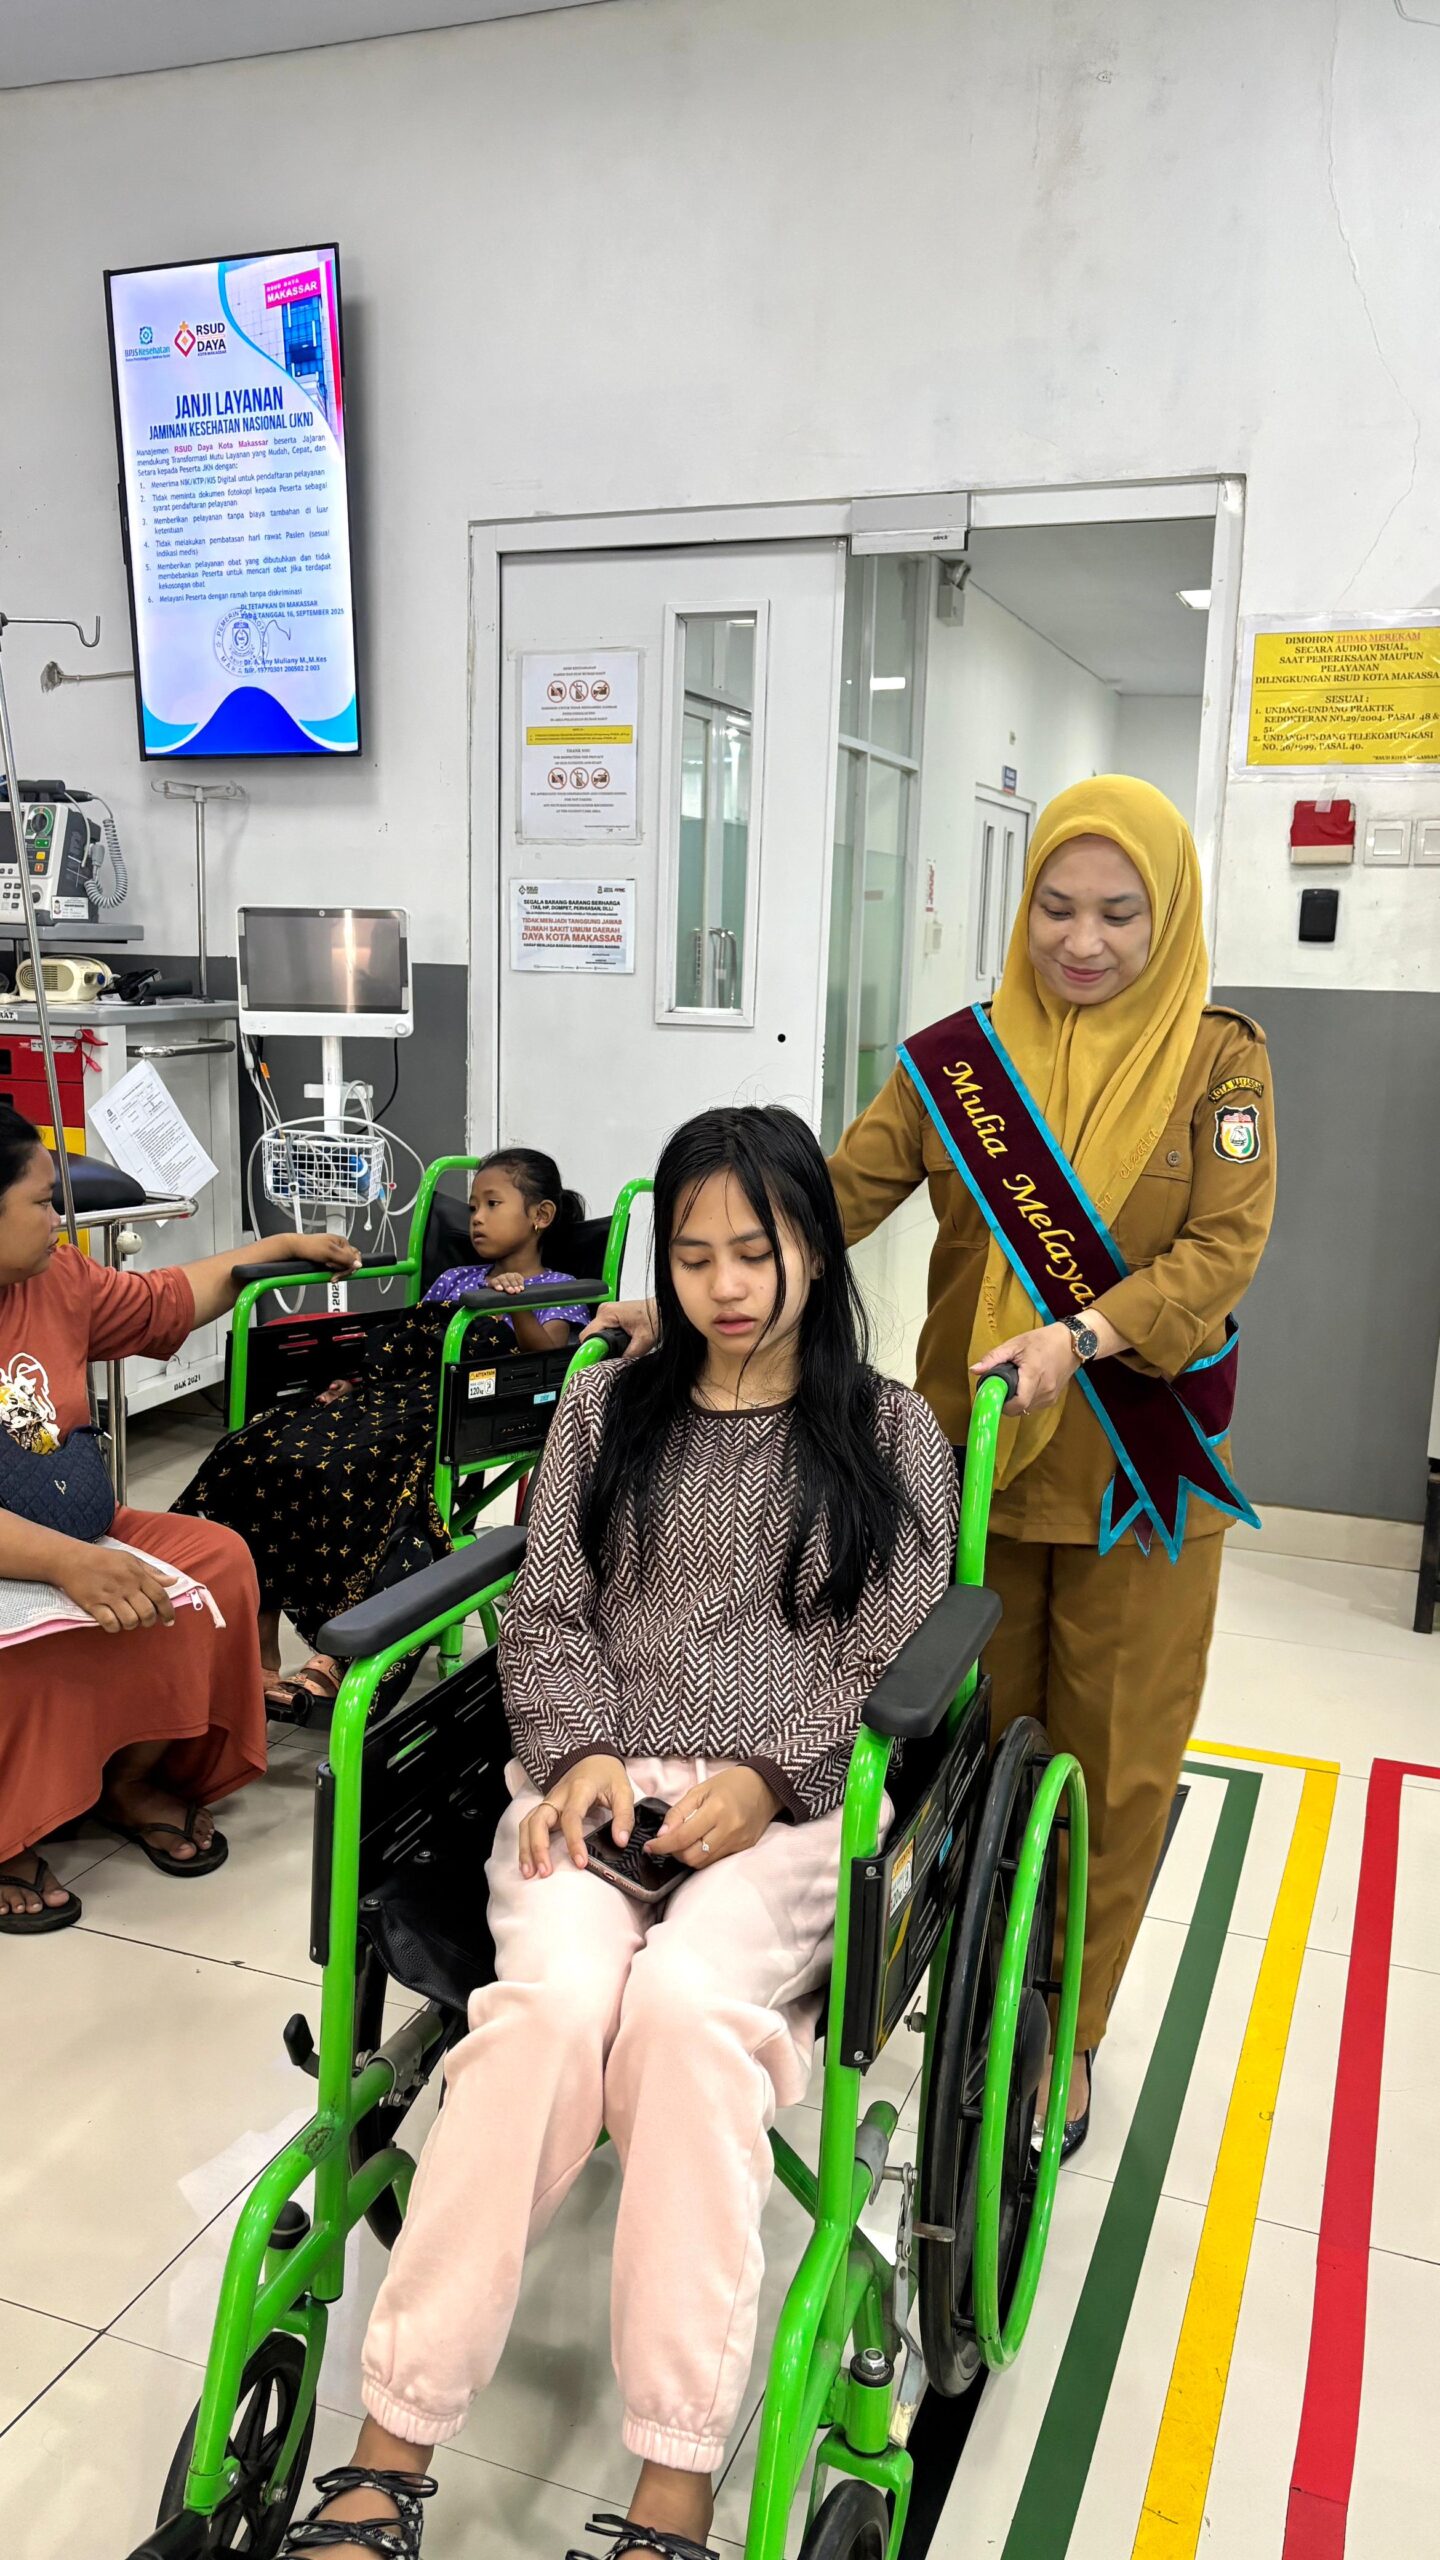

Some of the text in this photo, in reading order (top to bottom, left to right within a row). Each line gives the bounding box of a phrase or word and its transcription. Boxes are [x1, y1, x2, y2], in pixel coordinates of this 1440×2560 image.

[267, 281, 318, 303] MAKASSAR
[196, 323, 225, 335] RSUD
[139, 346, 170, 355] Kesehatan
[197, 339, 226, 352] DAYA
[175, 386, 284, 420] JANJI LAYANAN
[149, 412, 314, 440] JAMINAN KESEHATAN NASIONAL (JKN)
[137, 446, 169, 457] Manajemen
[174, 445, 192, 453] RSUD
[198, 444, 213, 452] Daya
[239, 439, 268, 448] Makassar
[274, 436, 297, 445] beserta
[303, 434, 326, 444] Jajaran
[137, 457, 170, 467] mendukung
[172, 454, 207, 464] Transformasi
[226, 451, 250, 461] Layanan
[252, 450, 267, 460] yang
[268, 448, 289, 457] Mudah,
[292, 446, 312, 456] Cepat,
[138, 462, 238, 477] Setara kepada Peserta JKN dengan:
[151, 479, 179, 488] Menerima
[218, 475, 237, 485] Digital
[238, 474, 255, 482] untuk
[256, 470, 292, 481] pendaftaran
[294, 468, 325, 479] pelayanan
[152, 493, 168, 501] Tidak
[171, 491, 196, 499] meminta
[199, 489, 225, 498] dokumen
[228, 488, 252, 497] fotokopi
[255, 485, 276, 495] kepada
[279, 483, 302, 492] Peserta
[305, 482, 327, 491] sebagai
[153, 499, 237, 512] syarat pendaftaran pelayanan
[154, 505, 329, 525] Memberikan pelayanan tanpa biaya tambahan di luar
[155, 526, 184, 535] ketentuan
[156, 539, 171, 547] Tidak
[175, 538, 206, 546] melakukan
[209, 535, 245, 546] pembatasan
[264, 533, 282, 541] rawat
[286, 531, 305, 539] Pasien
[309, 529, 330, 539] (sesuai
[156, 549, 178, 557] indikasi
[157, 561, 191, 570] Memberikan
[195, 560, 224, 569] pelayanan
[228, 558, 242, 566] obat
[245, 558, 259, 567] yang
[263, 555, 296, 564] dibutuhkan
[300, 553, 311, 561] dan
[315, 552, 331, 560] tidak
[158, 563, 331, 580] membebankan Peserta untuk mencari obat jika terdapat
[159, 581, 191, 590] kekosongan
[160, 587, 303, 603] Melayani Peserta dengan ramah tanpa diskriminasi
[296, 609, 329, 617] SEPTEMBER
[1285, 632, 1421, 644] DIMOHON TIDAK MEREKAM
[1295, 643, 1409, 653] SECARA AUDIO VISUAL,
[1280, 652, 1424, 664] SAAT PEMERIKSAAN MAUPUN
[1321, 663, 1380, 673] PELAYANAN
[1255, 671, 1440, 684] DILINGKUNGAN RSUD KOTA MAKASSA
[1325, 695, 1364, 704] SESUAI
[1265, 705, 1348, 714] UNDANG-UNDANG
[1350, 704, 1394, 713] PRAKTEK
[1419, 713, 1431, 721] 48
[1432, 712, 1440, 720] &
[1348, 731, 1434, 740] TELEKOMUNIKASI
[1262, 743, 1278, 751] NO.
[546, 933, 570, 941] KOTA
[572, 934, 622, 942] MAKASSAR
[943, 1060, 1098, 1311] Mulia Melaya
